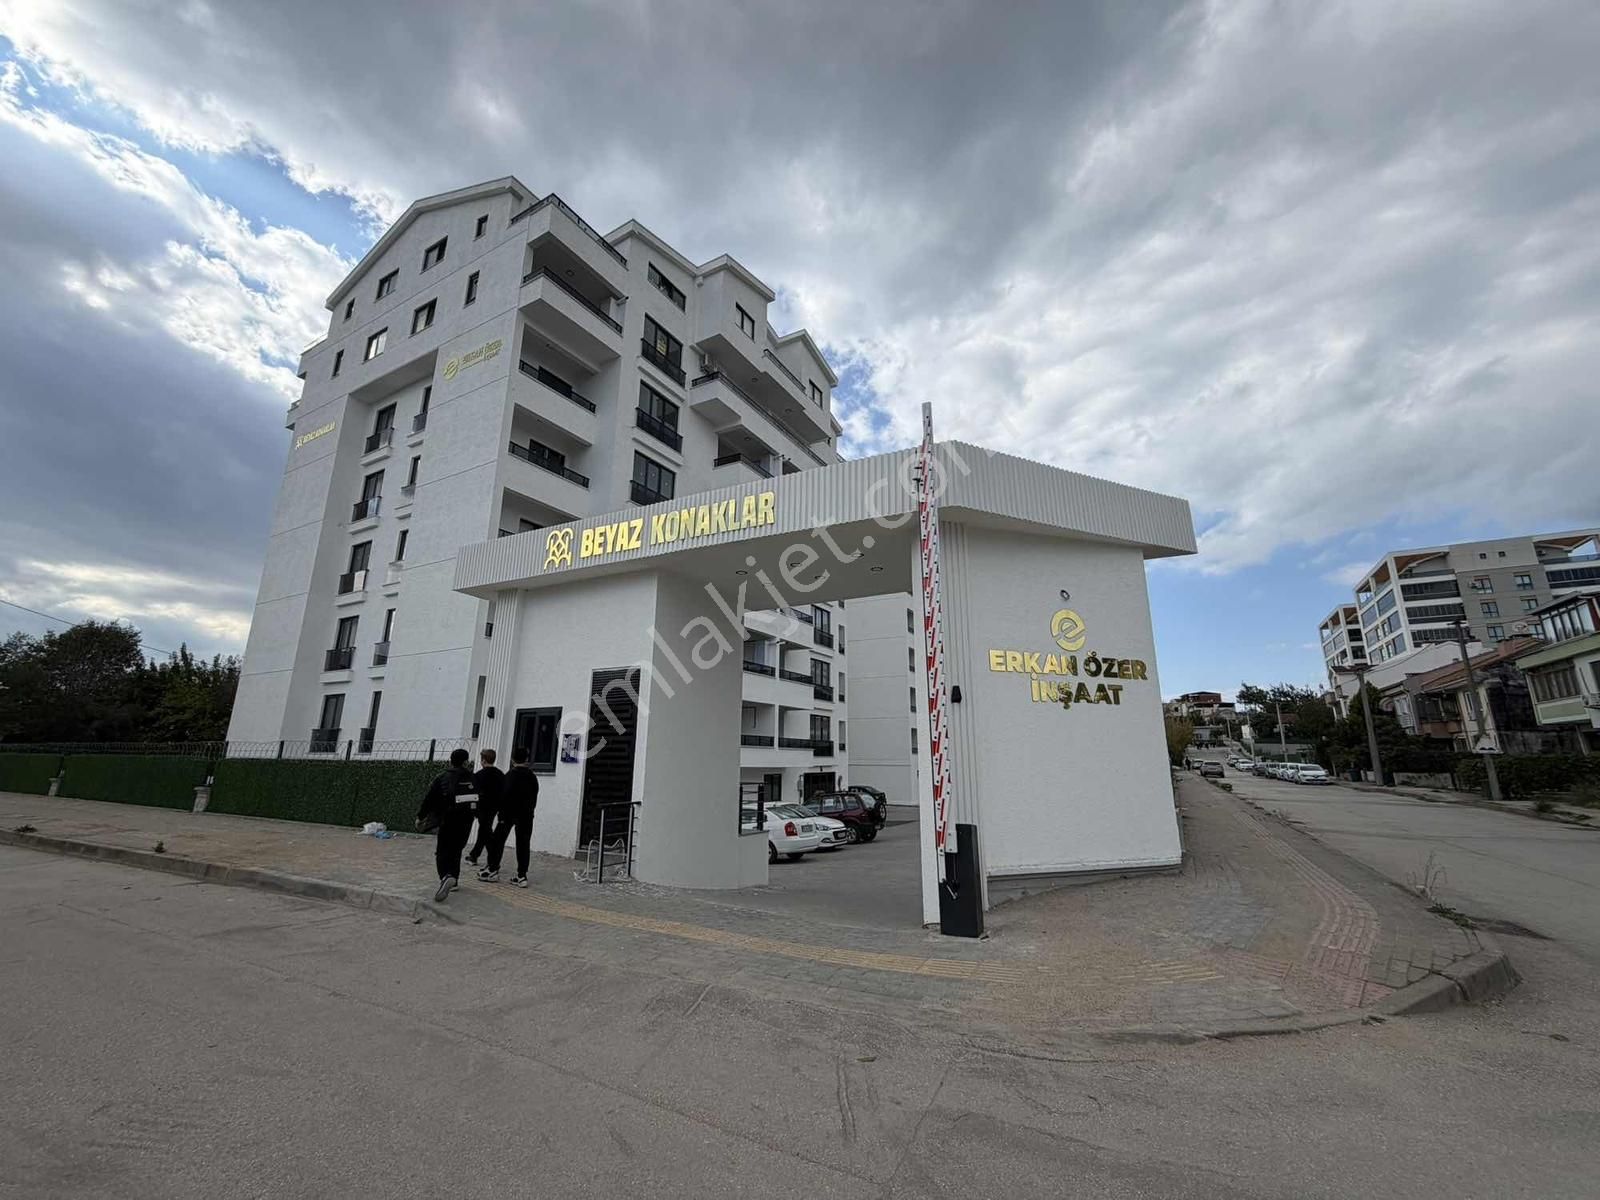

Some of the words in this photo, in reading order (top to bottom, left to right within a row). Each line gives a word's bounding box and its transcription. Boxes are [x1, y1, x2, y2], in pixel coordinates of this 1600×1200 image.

[580, 518, 645, 558] BEYAZ
[650, 490, 776, 545] KONAKLAR
[989, 648, 1079, 676] ERKAN
[1083, 650, 1148, 681] ÖZER
[1030, 673, 1123, 709] İNŞAAT
